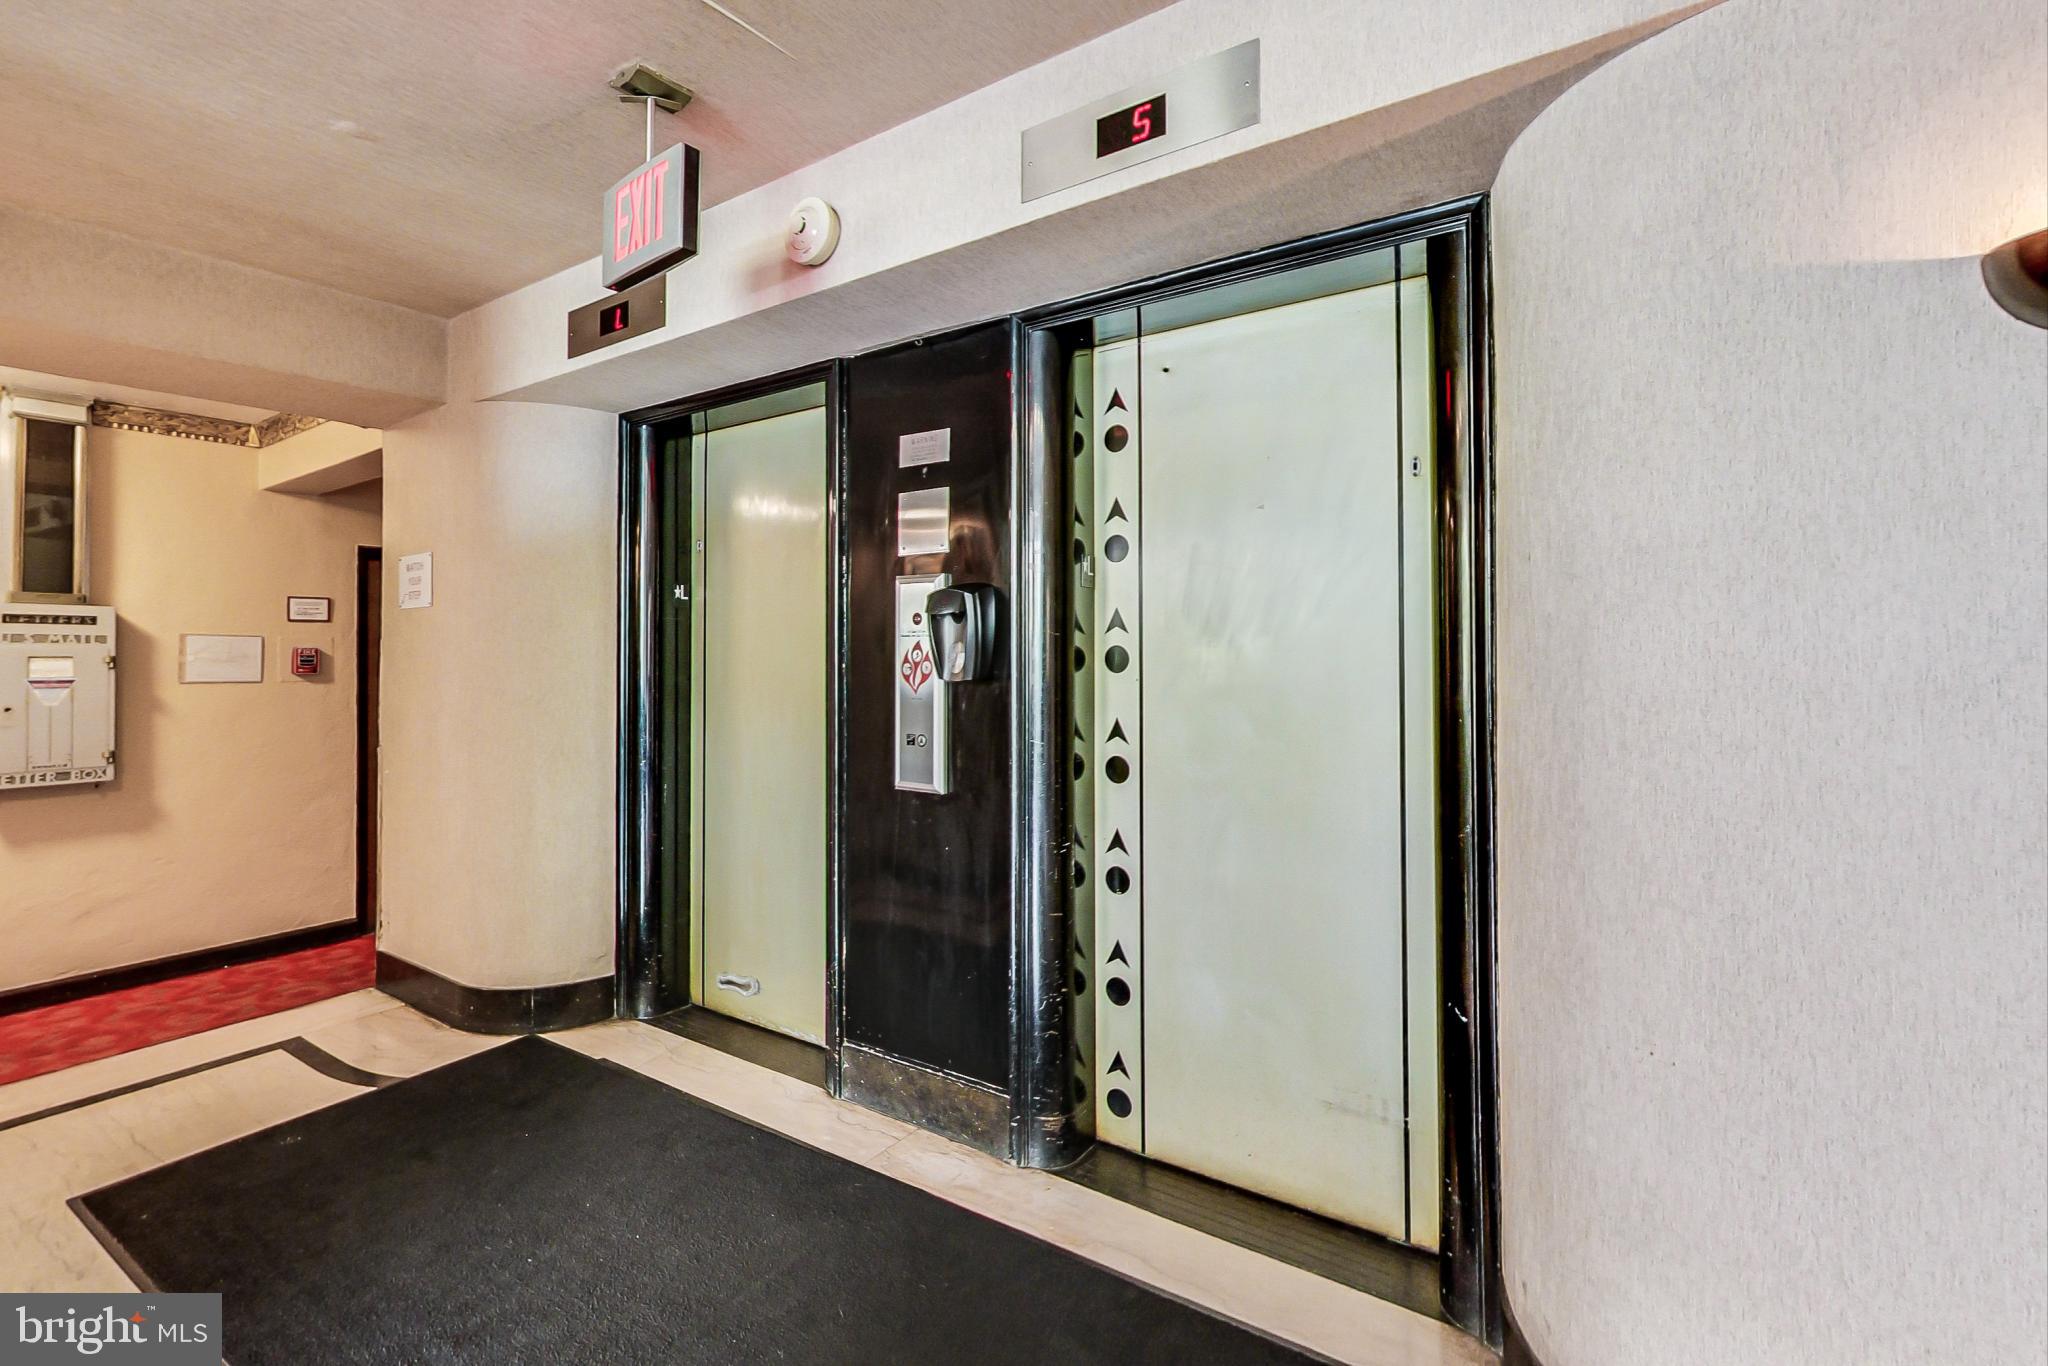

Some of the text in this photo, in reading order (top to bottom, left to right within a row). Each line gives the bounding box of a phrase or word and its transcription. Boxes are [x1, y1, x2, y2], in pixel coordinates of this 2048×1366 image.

[614, 160, 669, 263] EXIT
[614, 307, 624, 331] L
[0, 768, 108, 785] ETTER BOX
